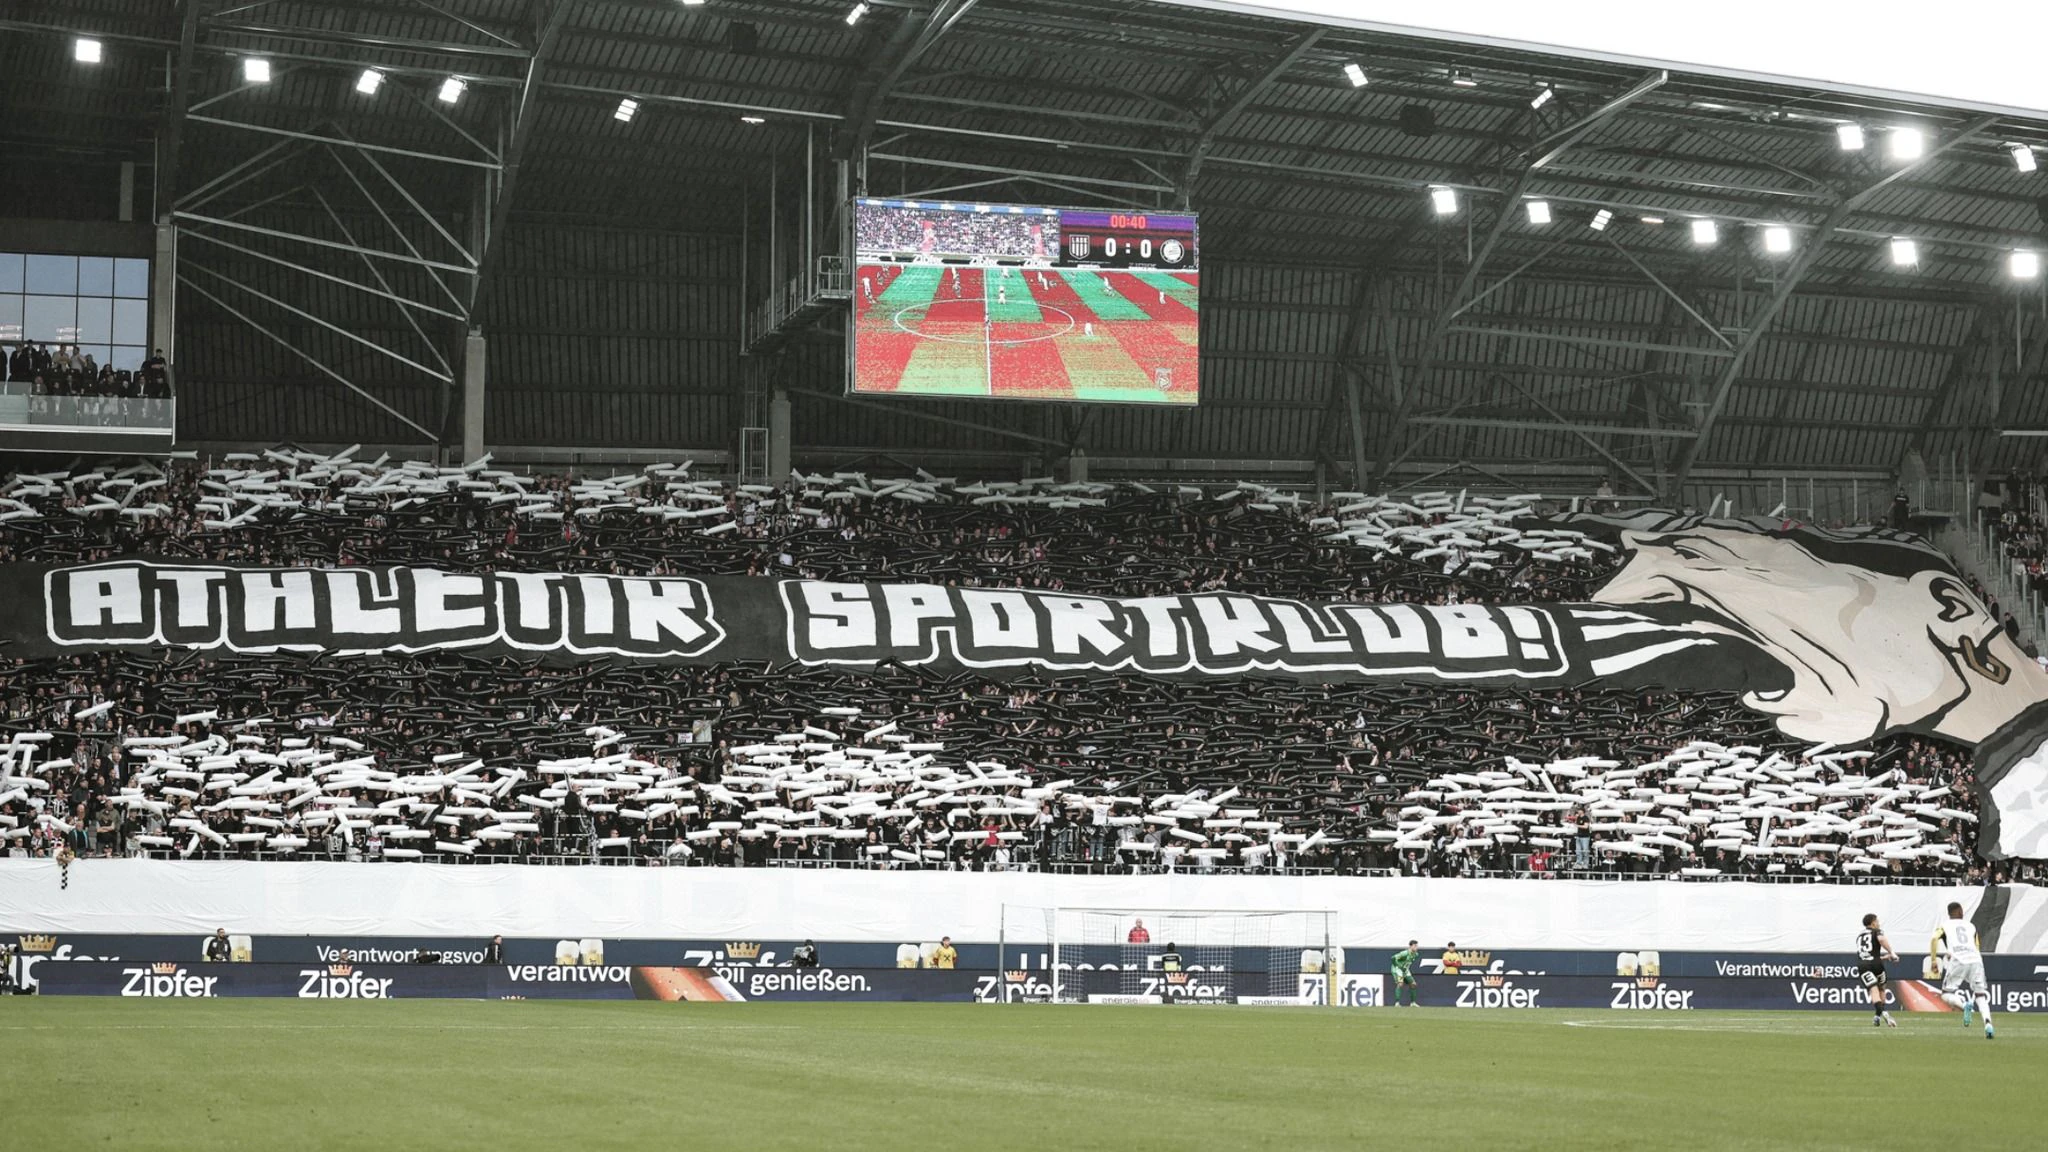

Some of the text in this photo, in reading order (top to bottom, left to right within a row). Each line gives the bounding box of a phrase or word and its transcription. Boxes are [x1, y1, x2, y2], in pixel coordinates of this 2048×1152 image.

[1110, 214, 1146, 229] 00:40
[1105, 238, 1117, 257] 0
[1140, 239, 1152, 258] 0
[68, 566, 1550, 659] ATHLETIK SPORTKLUB!
[1956, 926, 1969, 944] 6
[750, 968, 872, 996] genießen.
[1303, 979, 1380, 1006] Zifer
